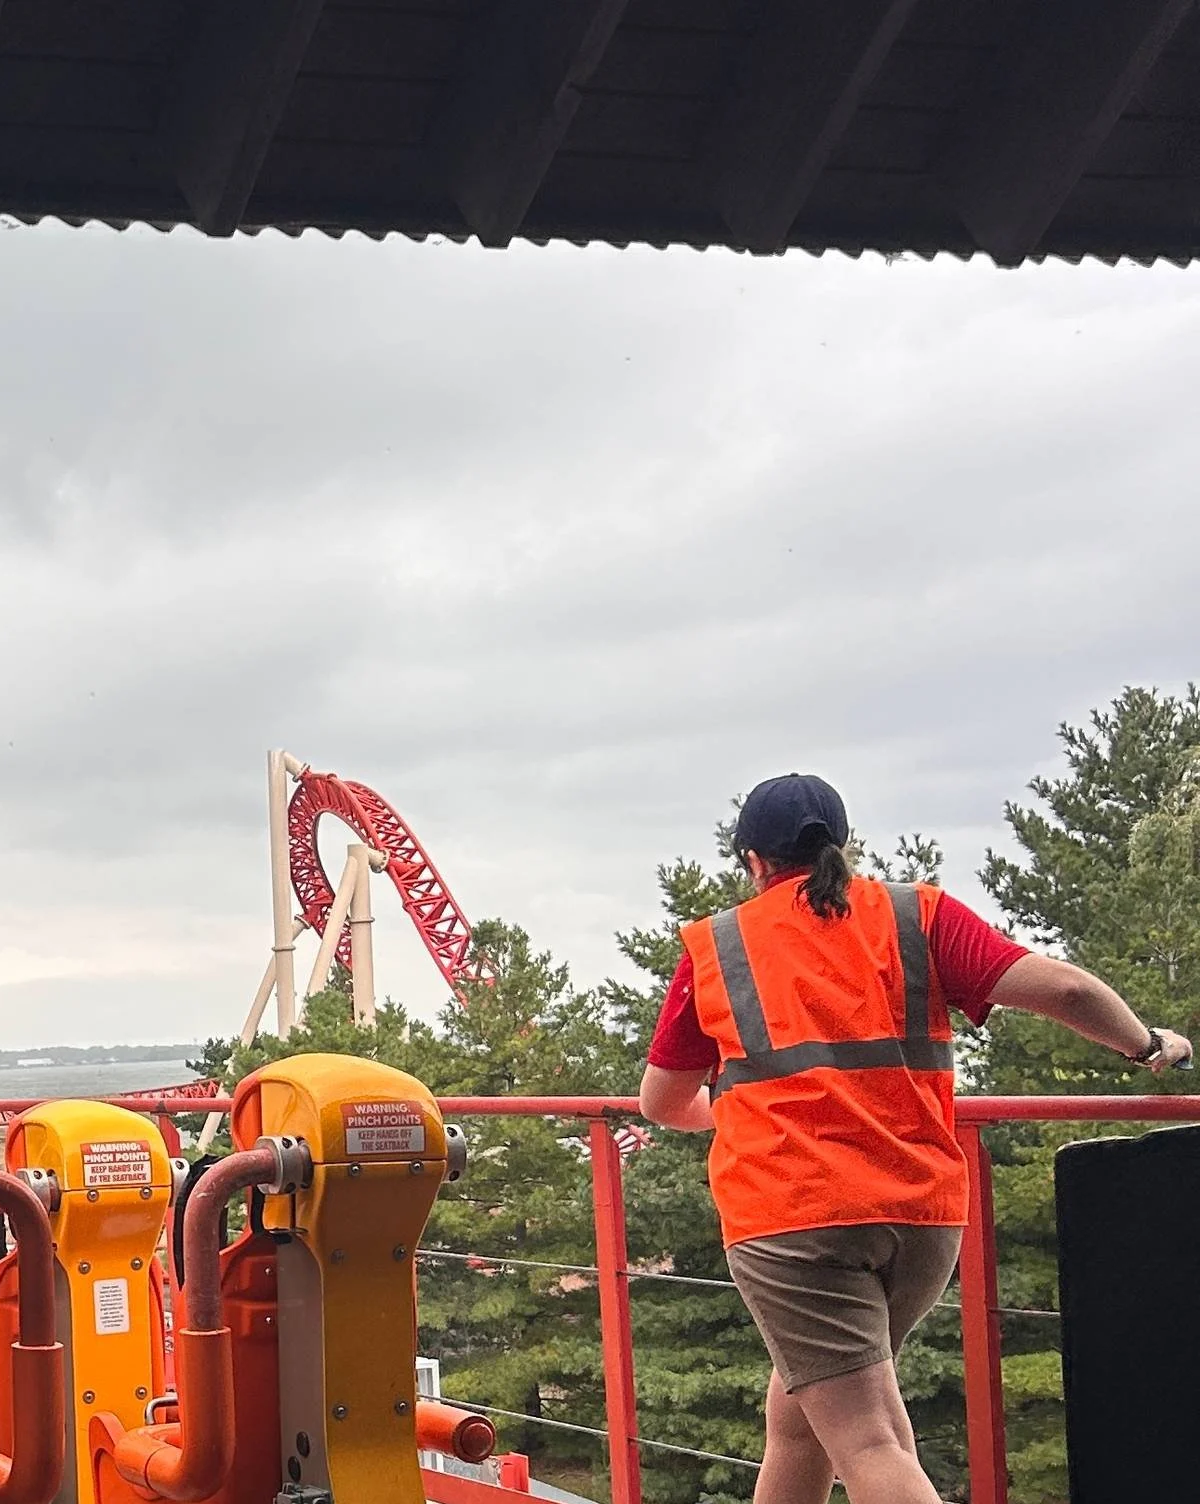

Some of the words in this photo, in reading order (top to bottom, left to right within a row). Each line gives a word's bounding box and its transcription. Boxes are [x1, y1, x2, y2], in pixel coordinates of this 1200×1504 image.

[347, 1115, 381, 1127] PINCH
[383, 1114, 421, 1125] POINTS
[358, 1130, 376, 1140] KEEP
[376, 1129, 399, 1139] HANDS
[400, 1128, 413, 1138] OFF
[361, 1141, 374, 1151] THE
[375, 1140, 410, 1151] SEATBACK
[83, 1153, 114, 1163] PINCH
[115, 1152, 150, 1162] POINTS
[91, 1166, 107, 1174] KEEP
[108, 1164, 131, 1173] HANDS
[99, 1175, 111, 1183] THE
[112, 1173, 147, 1182] SEATBACK
